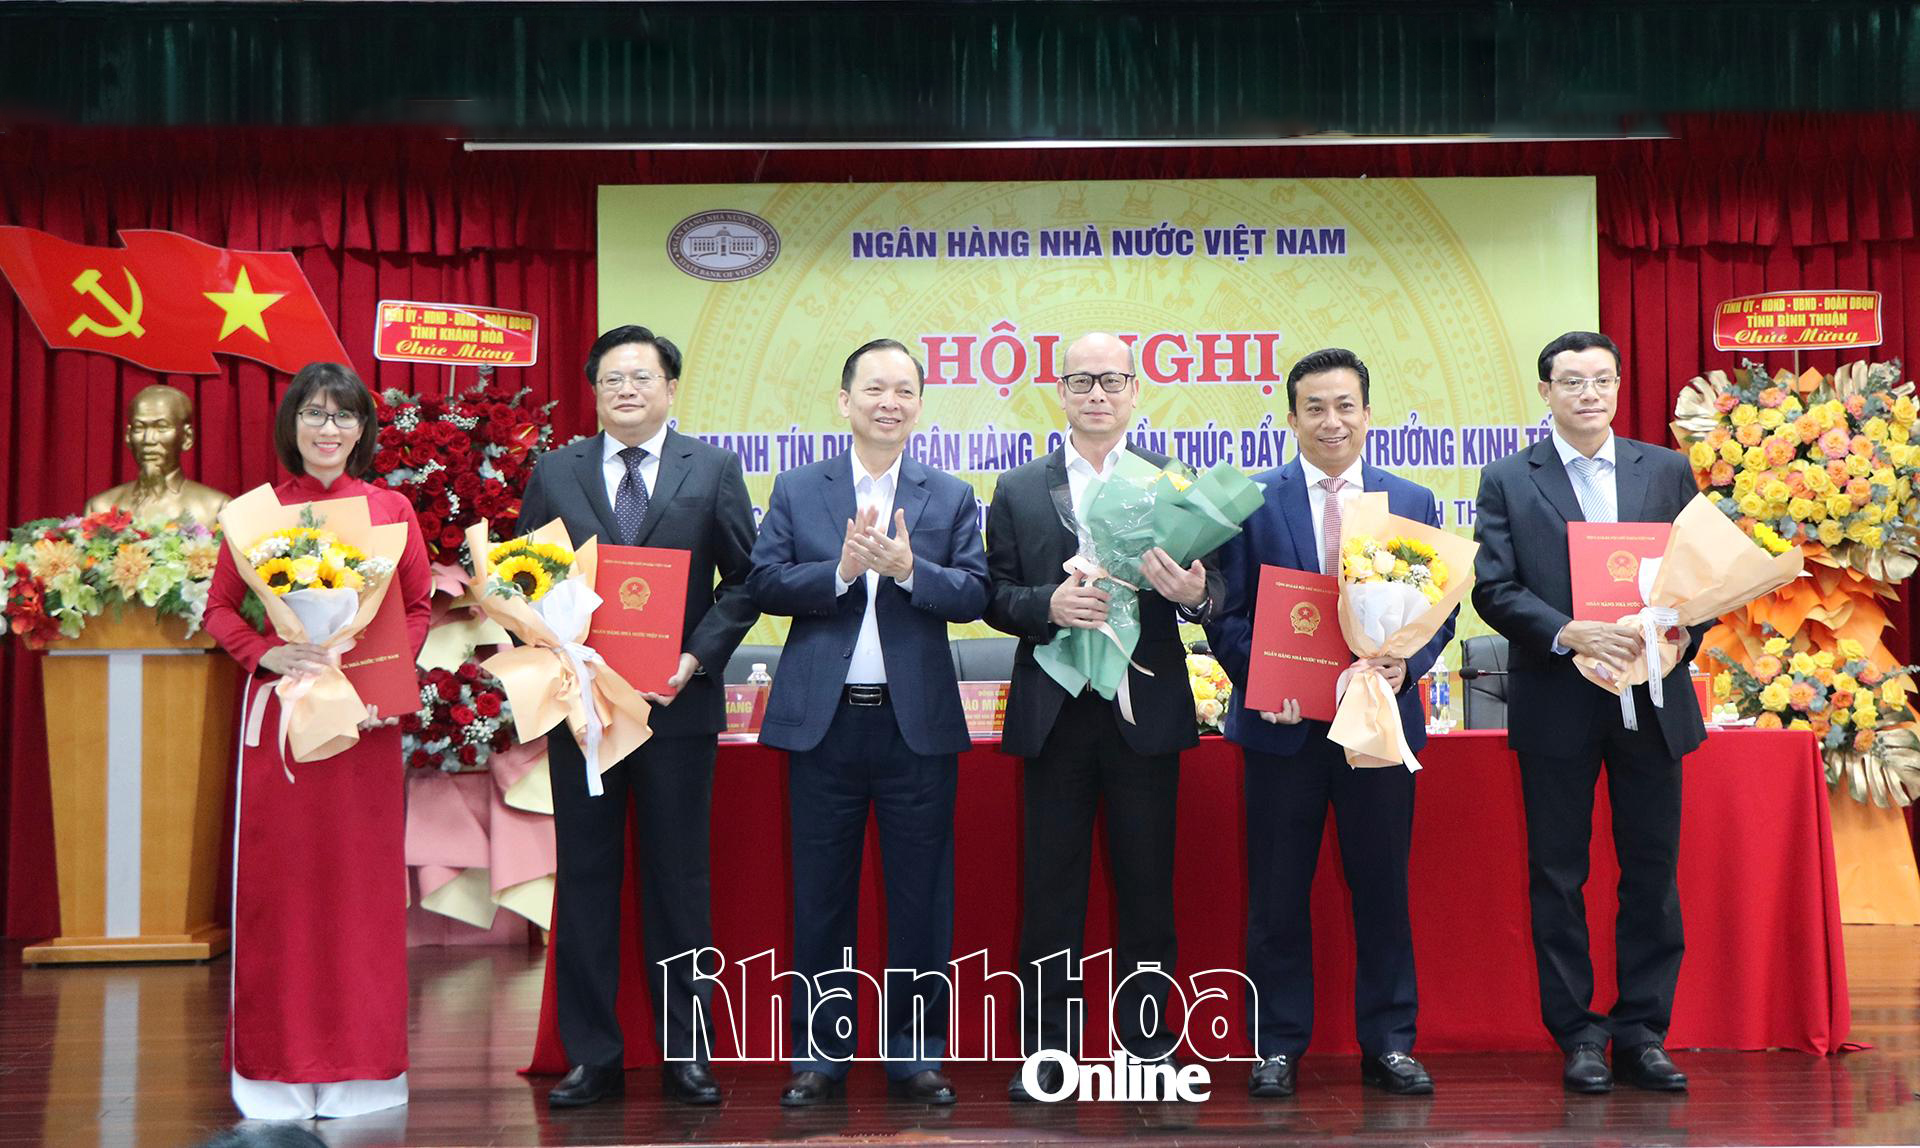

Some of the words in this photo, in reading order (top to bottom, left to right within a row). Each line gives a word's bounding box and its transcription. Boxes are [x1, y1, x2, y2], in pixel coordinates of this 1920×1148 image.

[852, 226, 937, 258] NGÂN
[947, 226, 1029, 257] HÀNG
[1040, 225, 1100, 257] NHÀ
[1112, 222, 1194, 256] NƯỚC
[1203, 224, 1266, 262] VIỆT
[1276, 227, 1346, 256] NAM
[1746, 314, 1774, 329] TỈNH
[1777, 313, 1806, 328] BÌNH
[1809, 311, 1848, 329] THUẬN
[410, 323, 437, 340] TỈNH
[440, 326, 478, 342] KHÁNH
[1734, 329, 1788, 344] Chúc
[396, 339, 447, 356] Chúc
[921, 320, 1060, 397] HỘI
[1119, 332, 1281, 395] GHỊ
[777, 427, 814, 472] TÍN
[903, 425, 960, 470] GÂN
[969, 425, 1032, 470] HÀNG
[1174, 423, 1233, 468] THÚC
[1241, 414, 1286, 468] ĐẨY
[1366, 412, 1455, 467] TRƯỞNG
[1462, 428, 1518, 466] KINH
